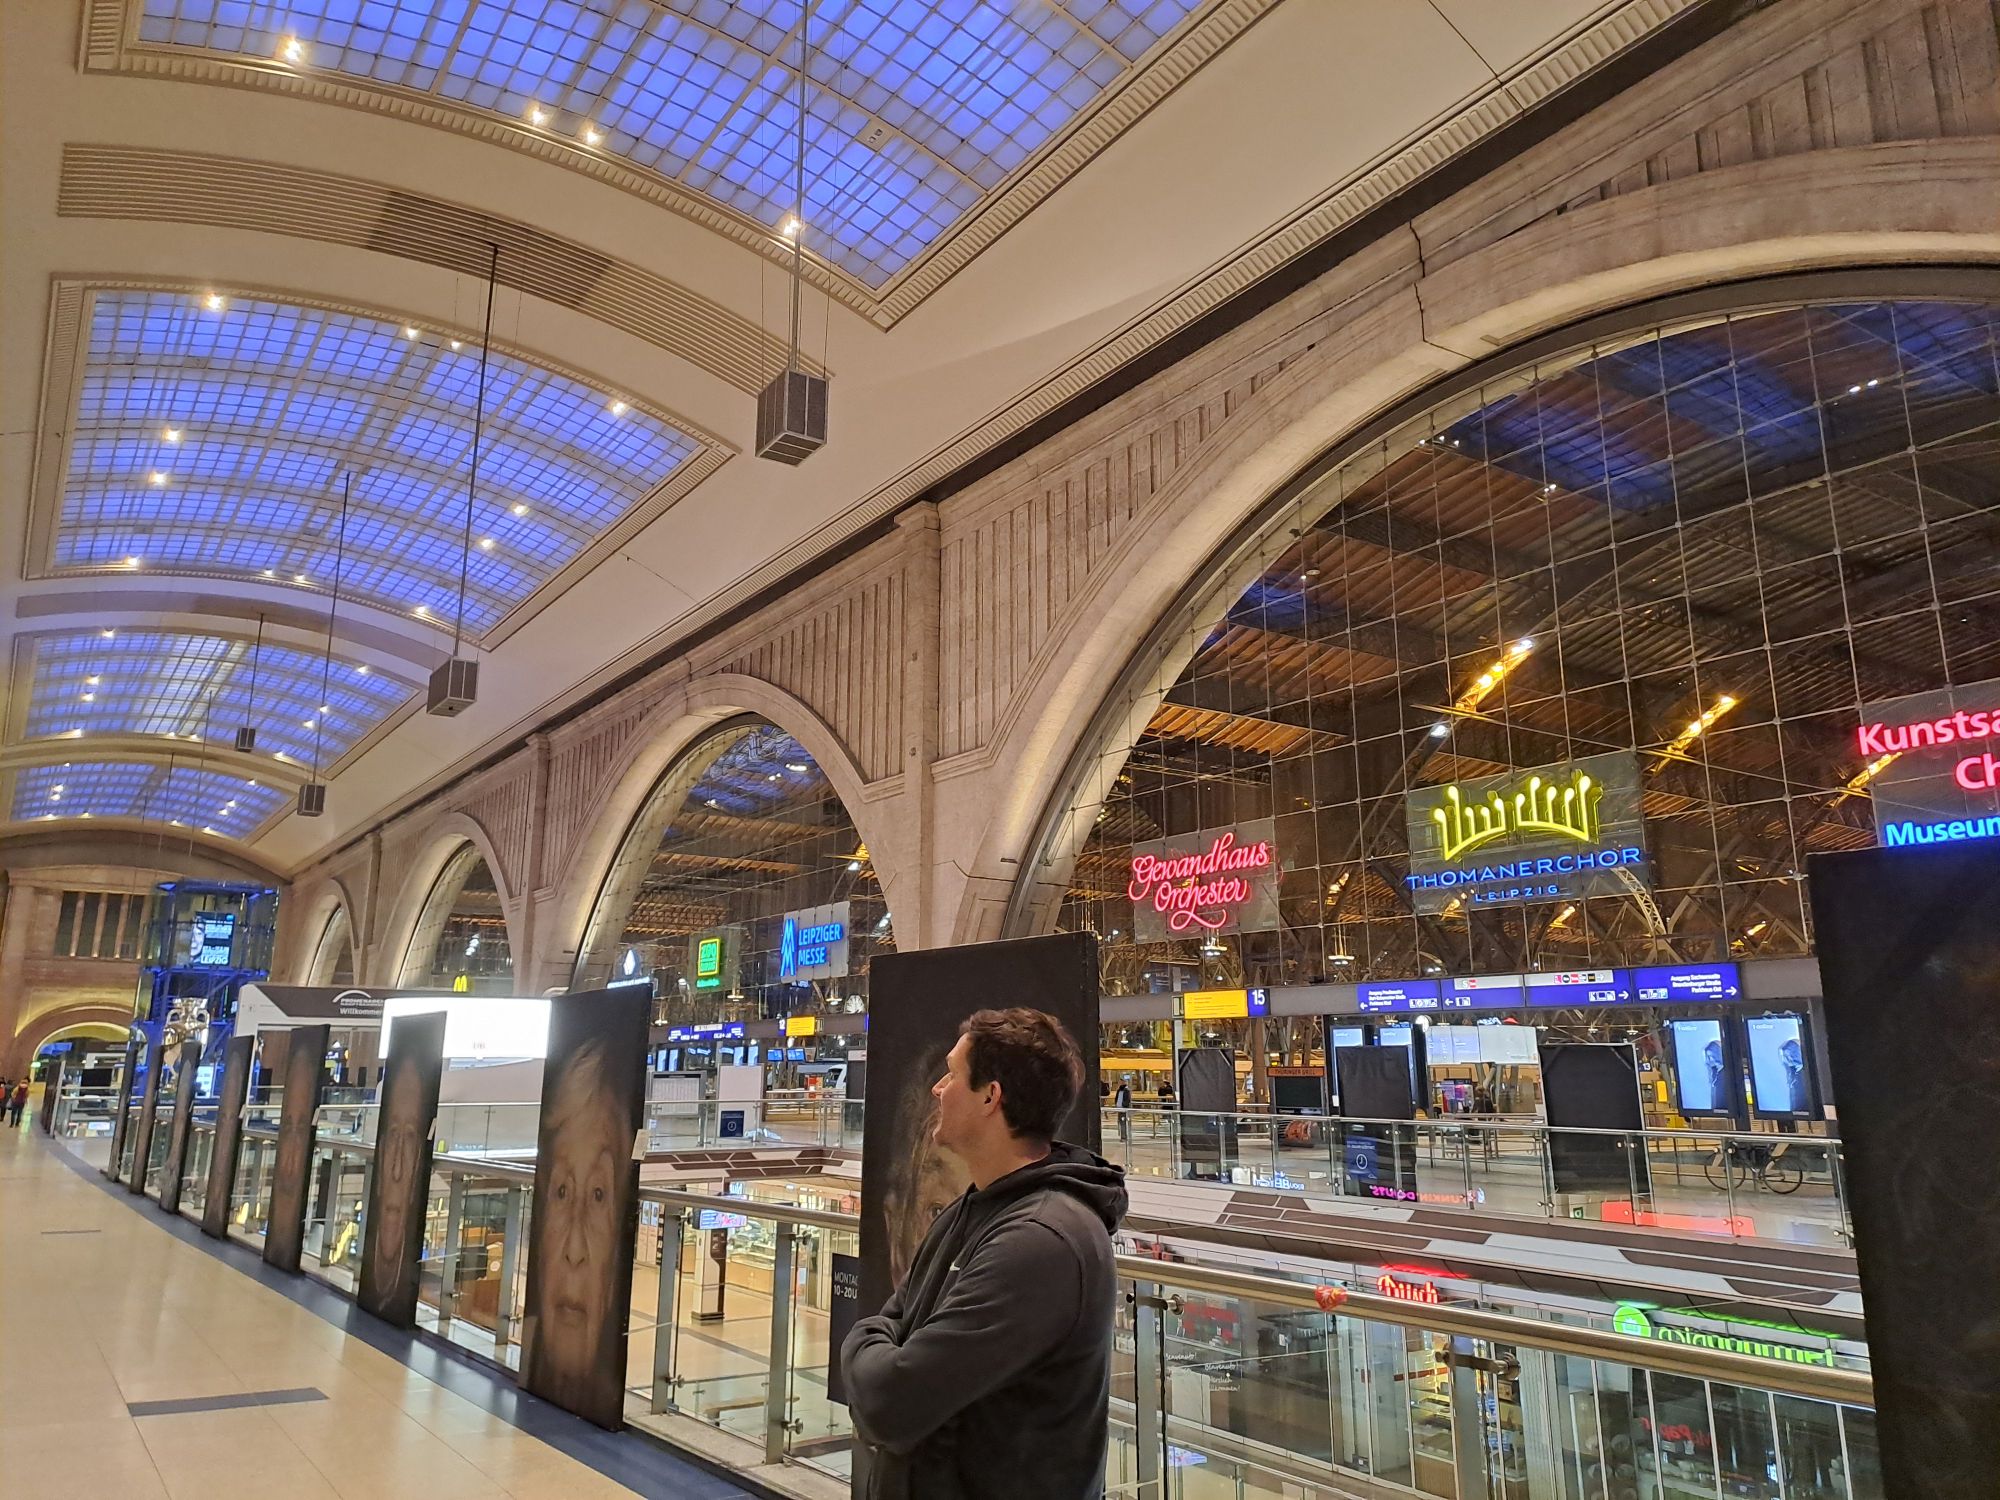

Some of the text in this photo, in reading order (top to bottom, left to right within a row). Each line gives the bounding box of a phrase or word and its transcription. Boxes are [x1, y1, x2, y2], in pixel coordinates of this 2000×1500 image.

[1128, 831, 1268, 900] Gewandhaus
[1407, 847, 1641, 890] THOMANERCHOR
[1154, 875, 1248, 930] Orchester
[1475, 884, 1559, 902] LEIPZIG
[798, 923, 842, 946] LEIPZIGER
[798, 946, 826, 966] MESSE
[1252, 989, 1266, 1005] 15
